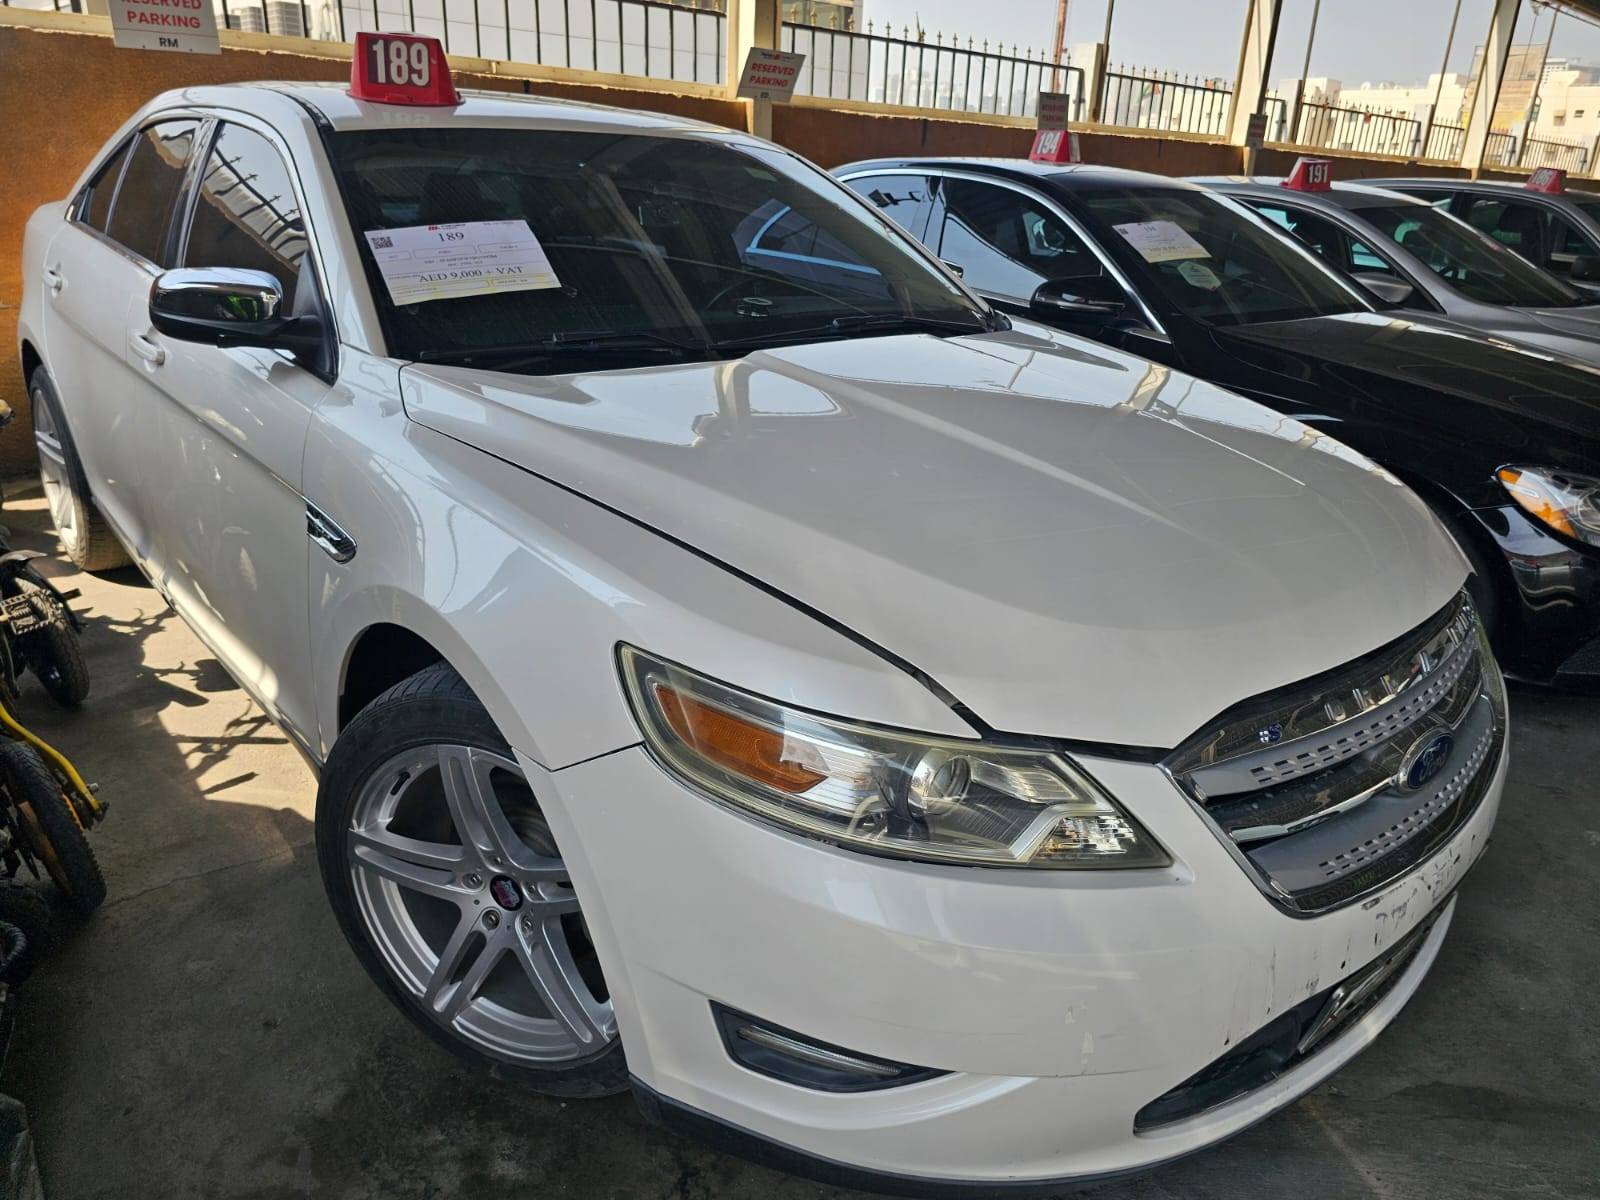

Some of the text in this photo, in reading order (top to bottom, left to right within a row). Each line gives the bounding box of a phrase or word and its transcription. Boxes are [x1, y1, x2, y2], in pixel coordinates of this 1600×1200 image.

[127, 11, 201, 28] PARKING
[159, 37, 179, 48] RM
[372, 39, 430, 87] 189
[751, 63, 795, 76] RESERVED
[750, 76, 788, 87] PARKING
[1036, 132, 1061, 155] 194
[1309, 164, 1329, 184] 191
[438, 232, 465, 243] 189
[419, 273, 448, 283] AED
[450, 269, 482, 281] 9,000
[495, 266, 524, 275] VAT
